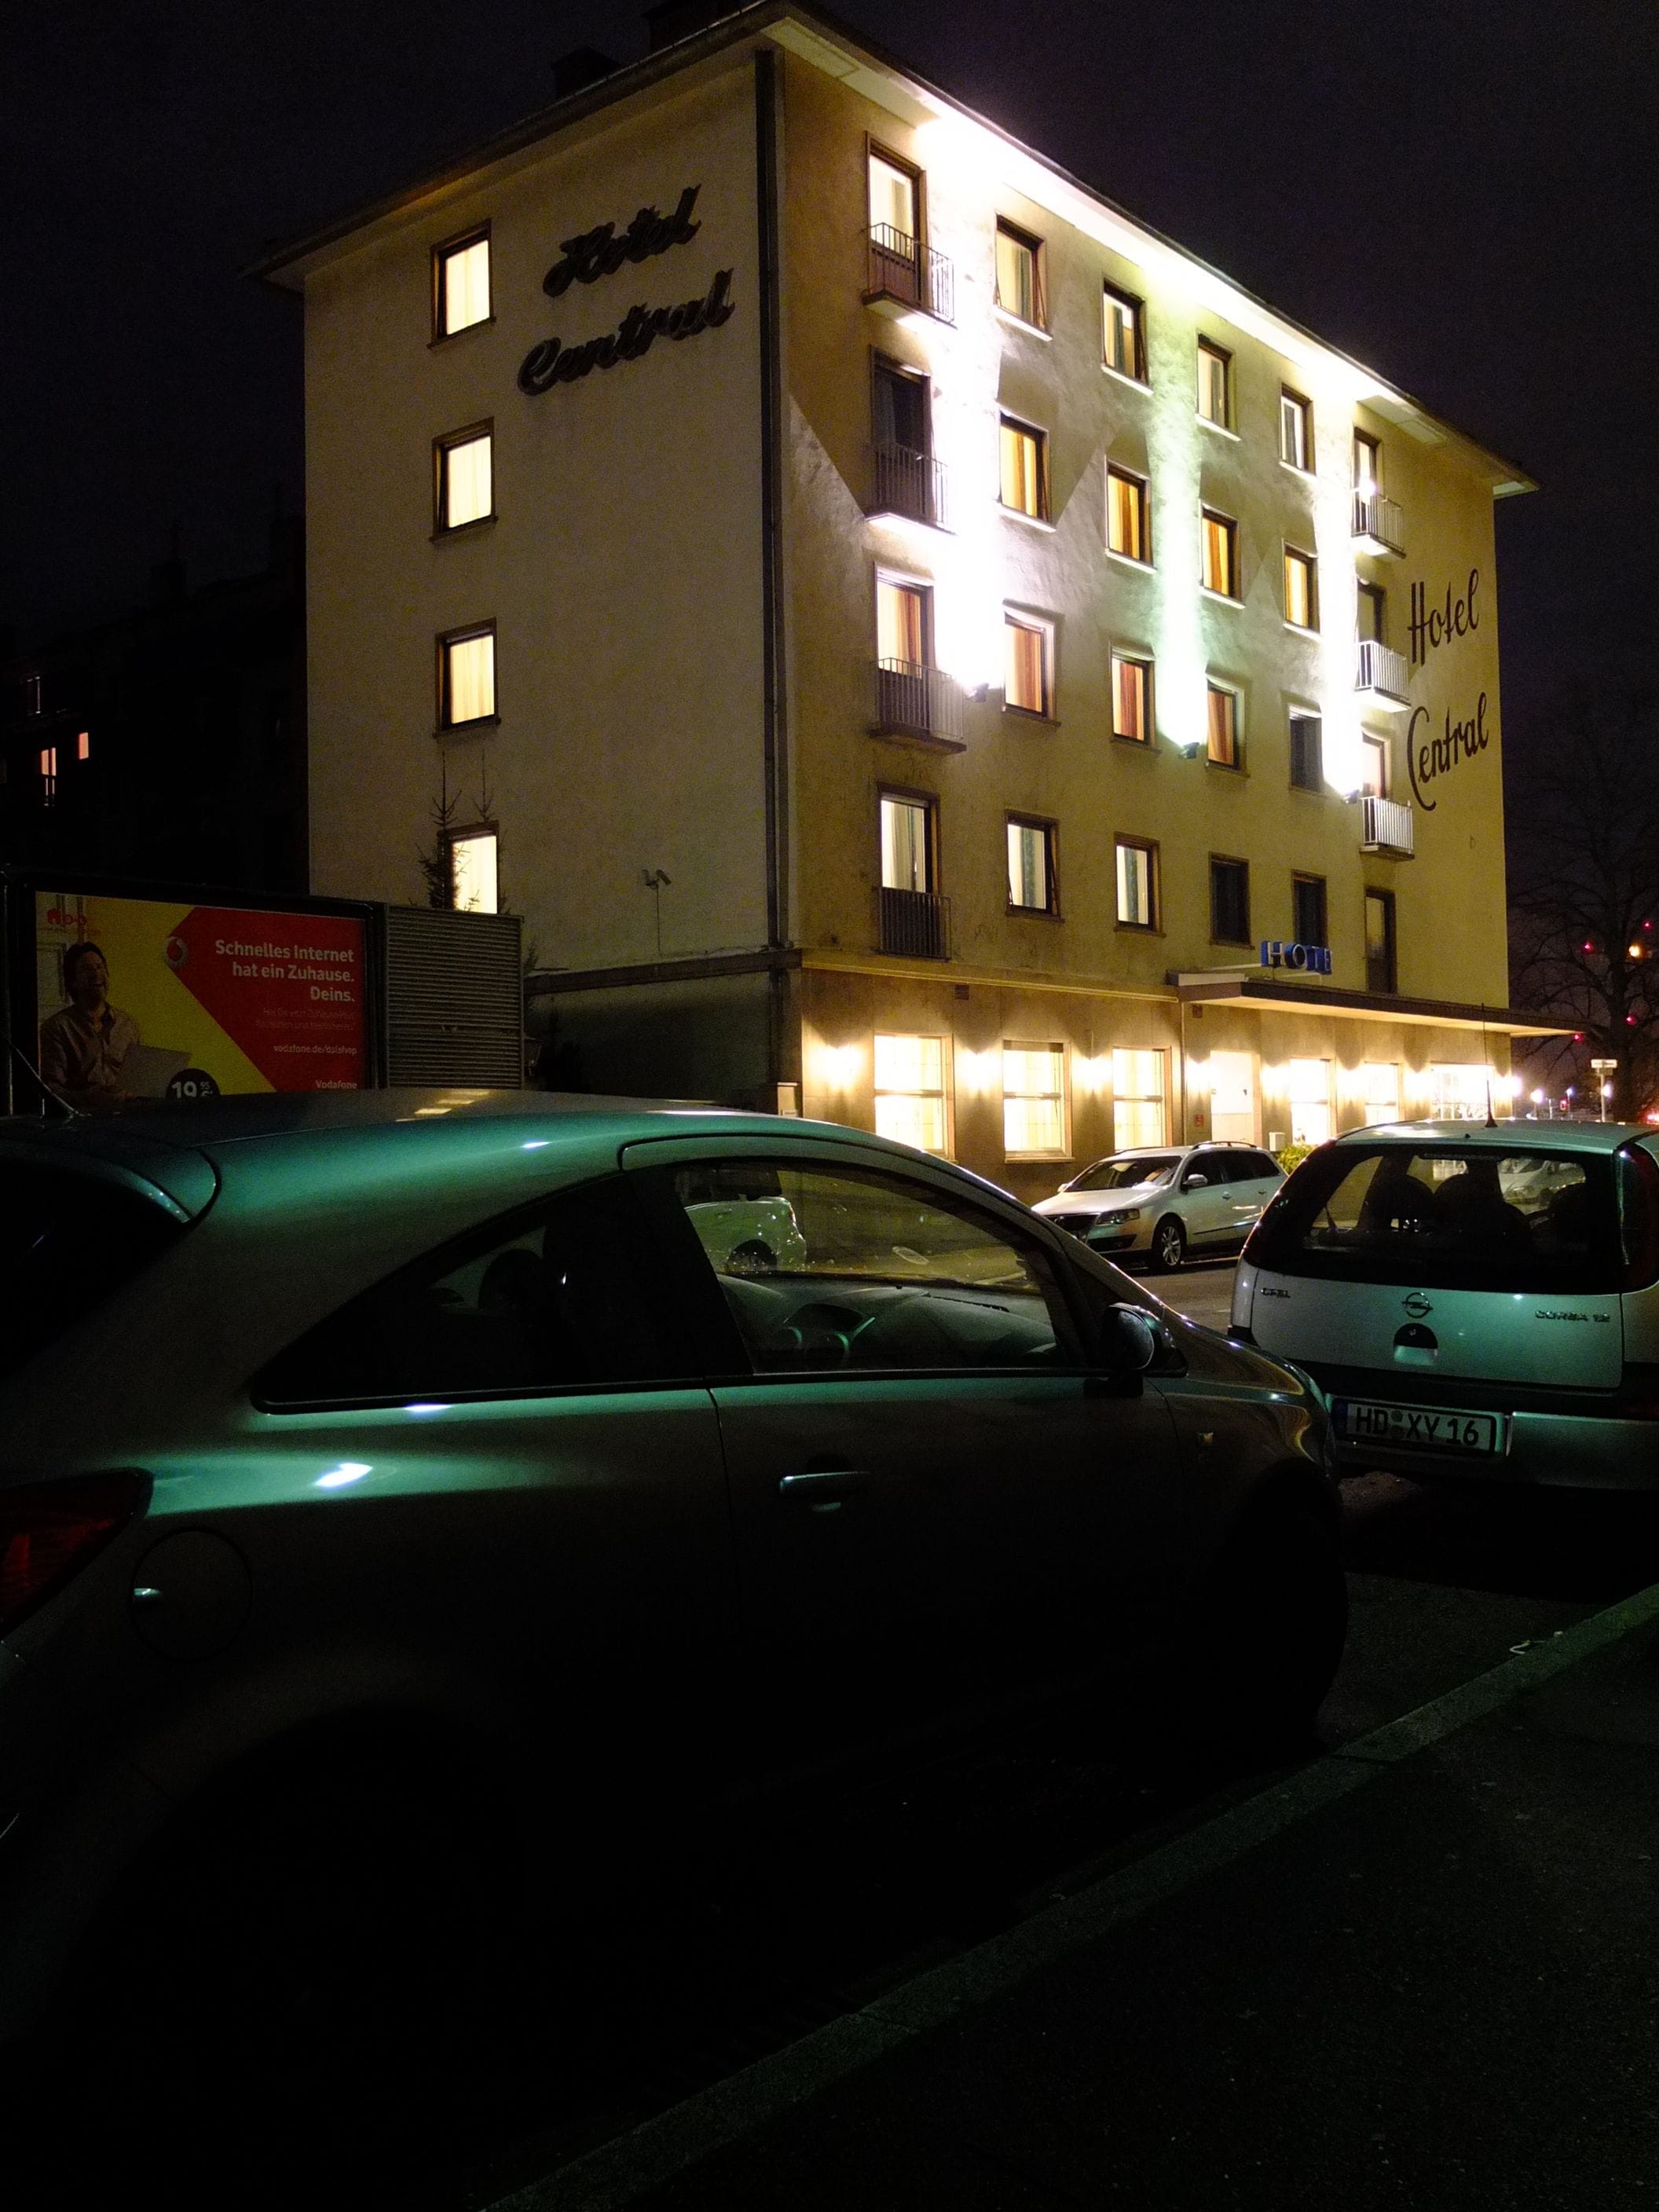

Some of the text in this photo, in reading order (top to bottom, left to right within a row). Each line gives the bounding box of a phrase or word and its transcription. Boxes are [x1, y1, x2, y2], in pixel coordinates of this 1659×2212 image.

[542, 184, 701, 298] Hotel
[517, 268, 735, 396] Central
[1408, 569, 1479, 666] Hotel
[1407, 692, 1489, 811] Central
[214, 939, 355, 963] Schnelles Internet
[232, 961, 356, 983] hat ein Zuhause.
[309, 985, 356, 1002] Deins.
[314, 1079, 357, 1089] Vodafone
[1447, 1418, 1479, 1446] 16
